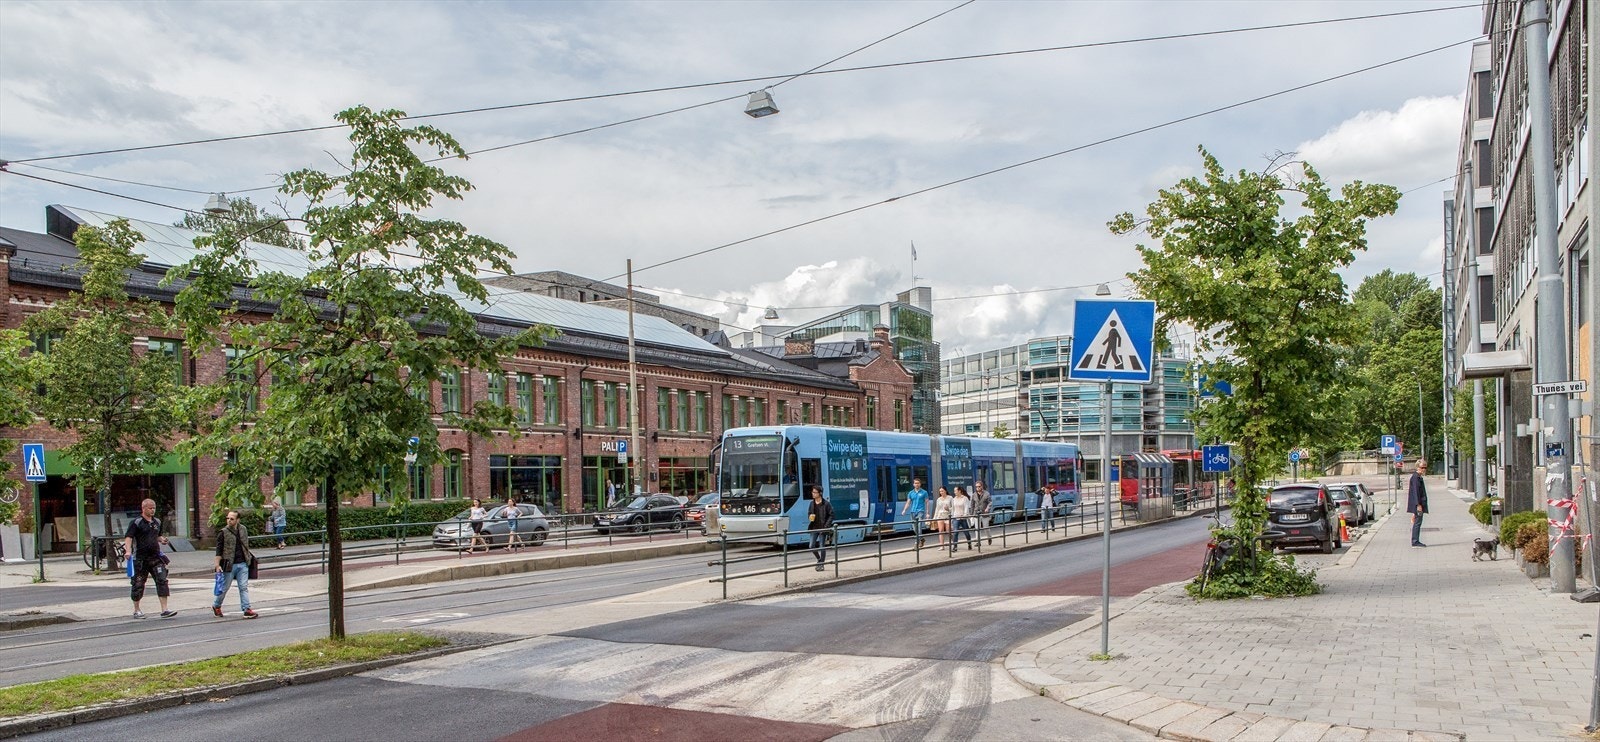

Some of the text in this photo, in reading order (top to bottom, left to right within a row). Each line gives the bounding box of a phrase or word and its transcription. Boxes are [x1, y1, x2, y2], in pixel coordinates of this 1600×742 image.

[1536, 382, 1583, 393] Thunes vei
[620, 442, 625, 451] P
[734, 440, 742, 449] 13
[1385, 437, 1393, 446] P
[828, 439, 863, 456] Swipe deg
[945, 444, 969, 458] Swipe deg
[829, 459, 840, 471] fra
[841, 459, 847, 471] A
[744, 505, 756, 513] 146
